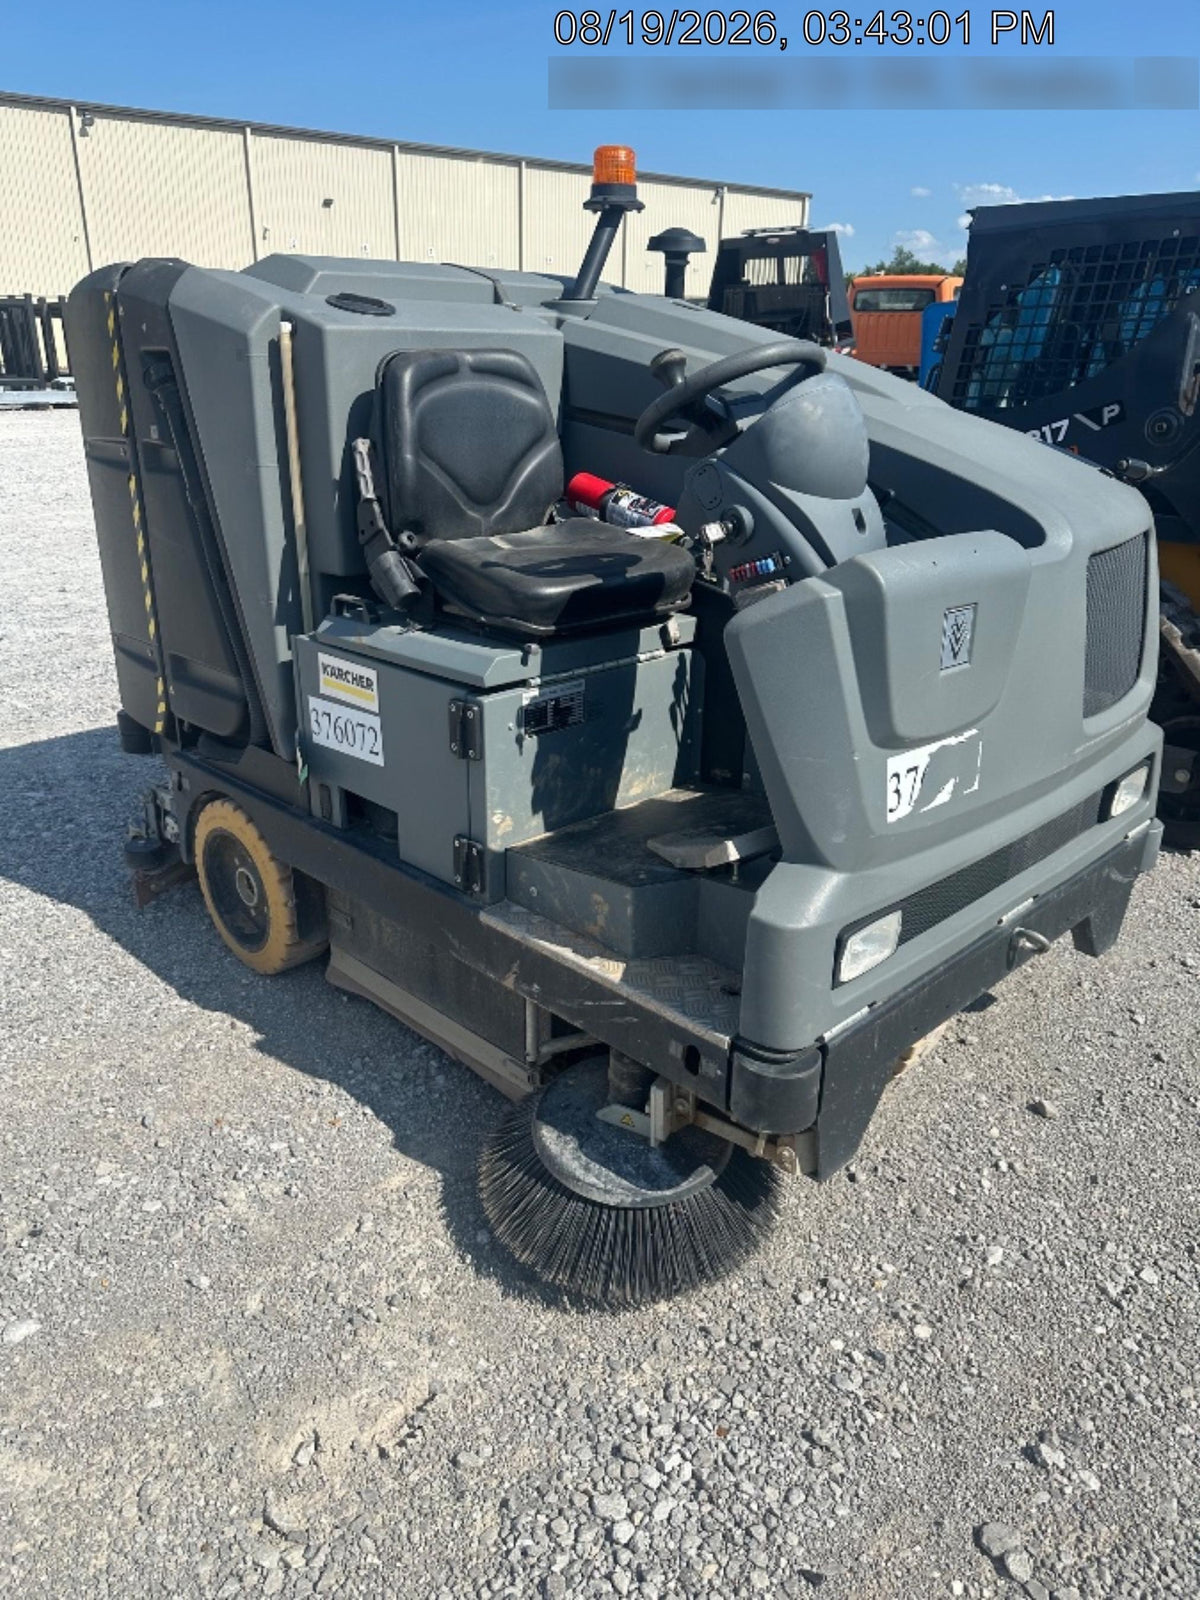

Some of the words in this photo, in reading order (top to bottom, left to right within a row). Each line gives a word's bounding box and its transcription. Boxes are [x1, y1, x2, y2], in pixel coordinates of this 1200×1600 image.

[1102, 403, 1121, 426] P
[310, 708, 379, 756] 376072
[888, 764, 928, 814] 37
